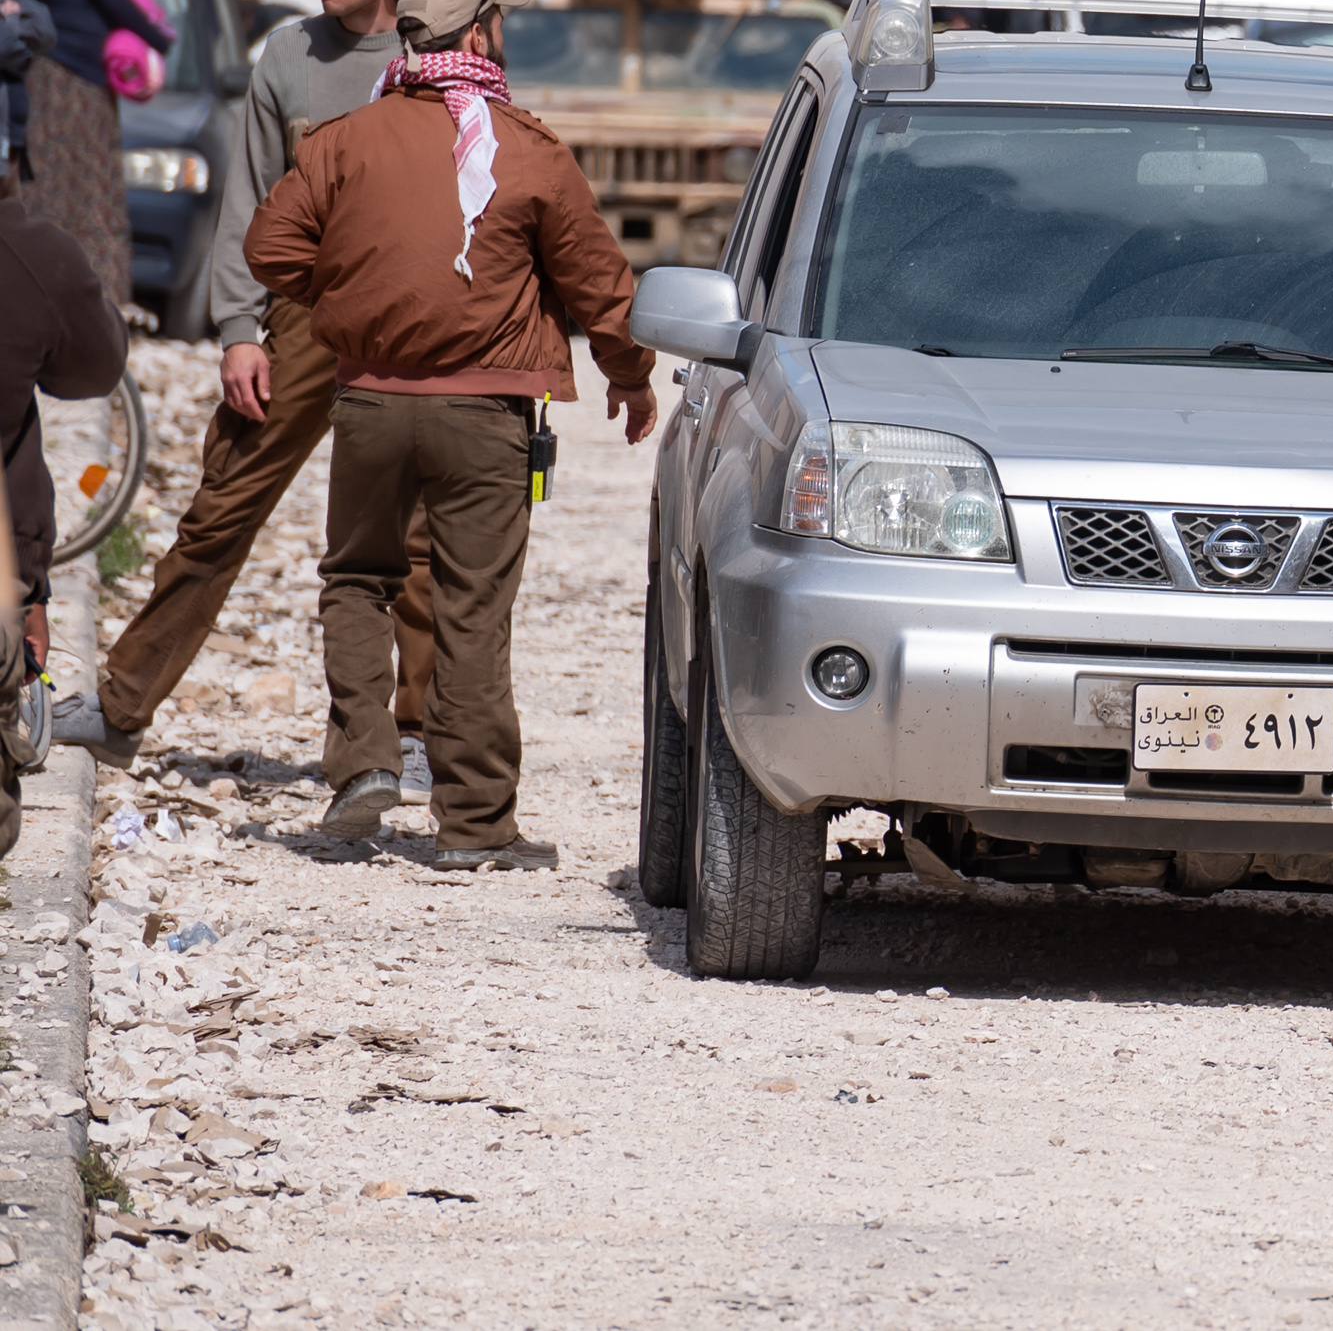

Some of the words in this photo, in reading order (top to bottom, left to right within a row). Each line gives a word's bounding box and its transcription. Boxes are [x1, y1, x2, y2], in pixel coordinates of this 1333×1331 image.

[1211, 544, 1262, 554] NISSAN
[1139, 706, 1198, 725] العراق
[1138, 730, 1200, 753] نينوى
[1244, 712, 1324, 750] ٤٩١٢
